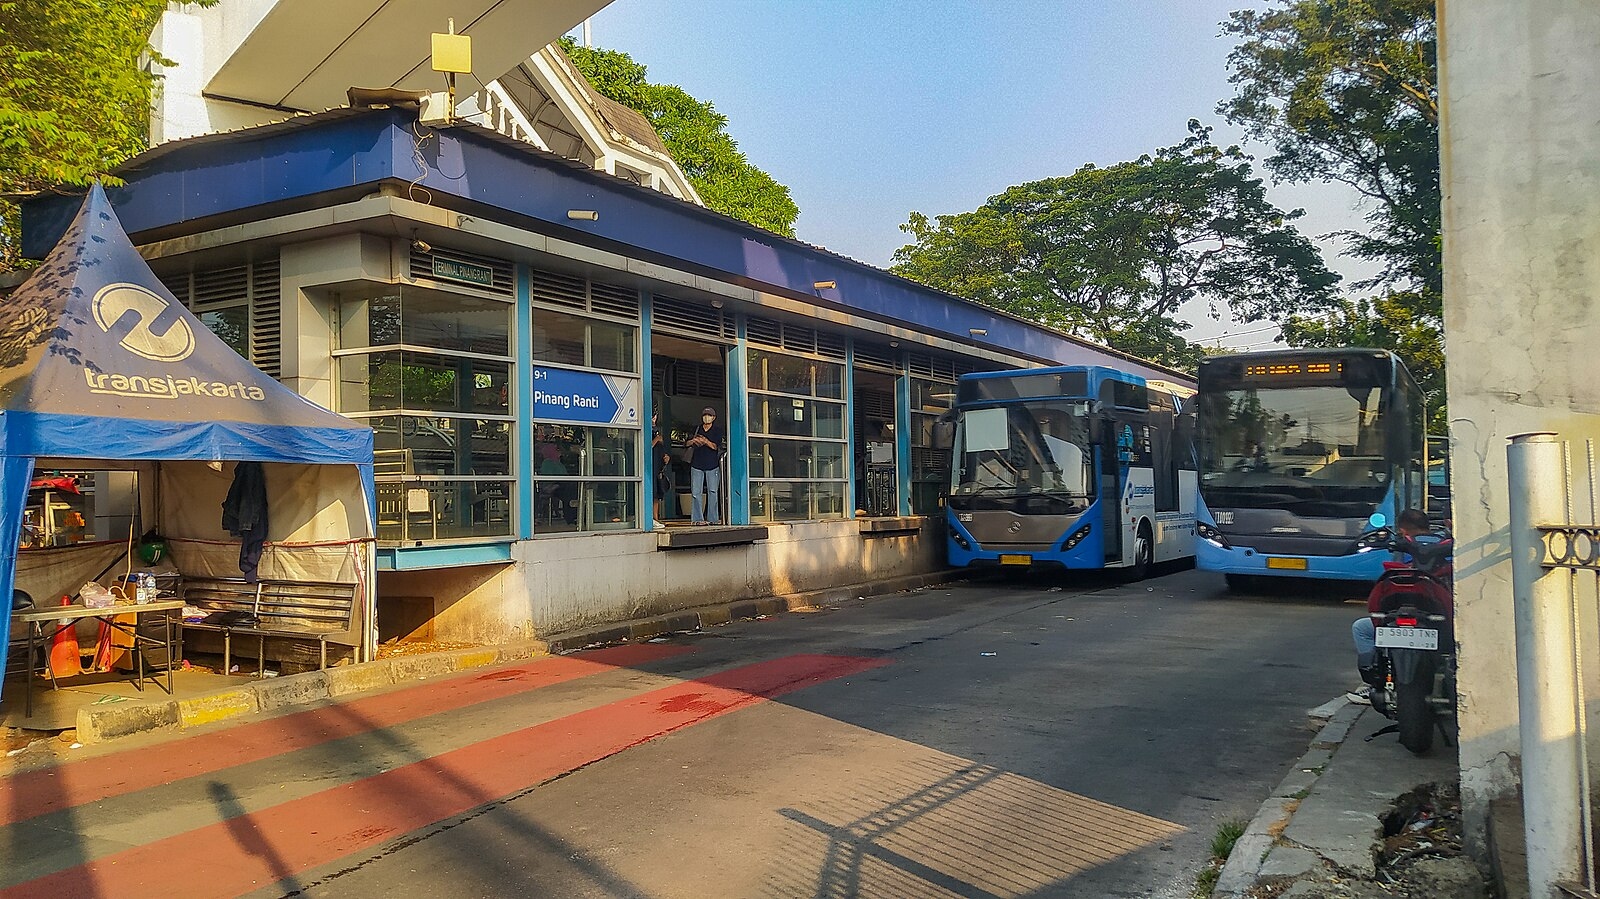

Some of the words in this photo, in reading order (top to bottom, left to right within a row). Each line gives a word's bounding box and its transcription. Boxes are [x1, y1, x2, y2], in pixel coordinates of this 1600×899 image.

[435, 260, 459, 276] TERMINAL
[534, 370, 547, 380] 9-1
[84, 367, 265, 400] transjakarta
[534, 390, 570, 409] Pinang
[573, 394, 599, 409] Ranti
[1378, 628, 1384, 637] B
[1389, 628, 1415, 638] 5903
[1419, 629, 1437, 639] TNR
